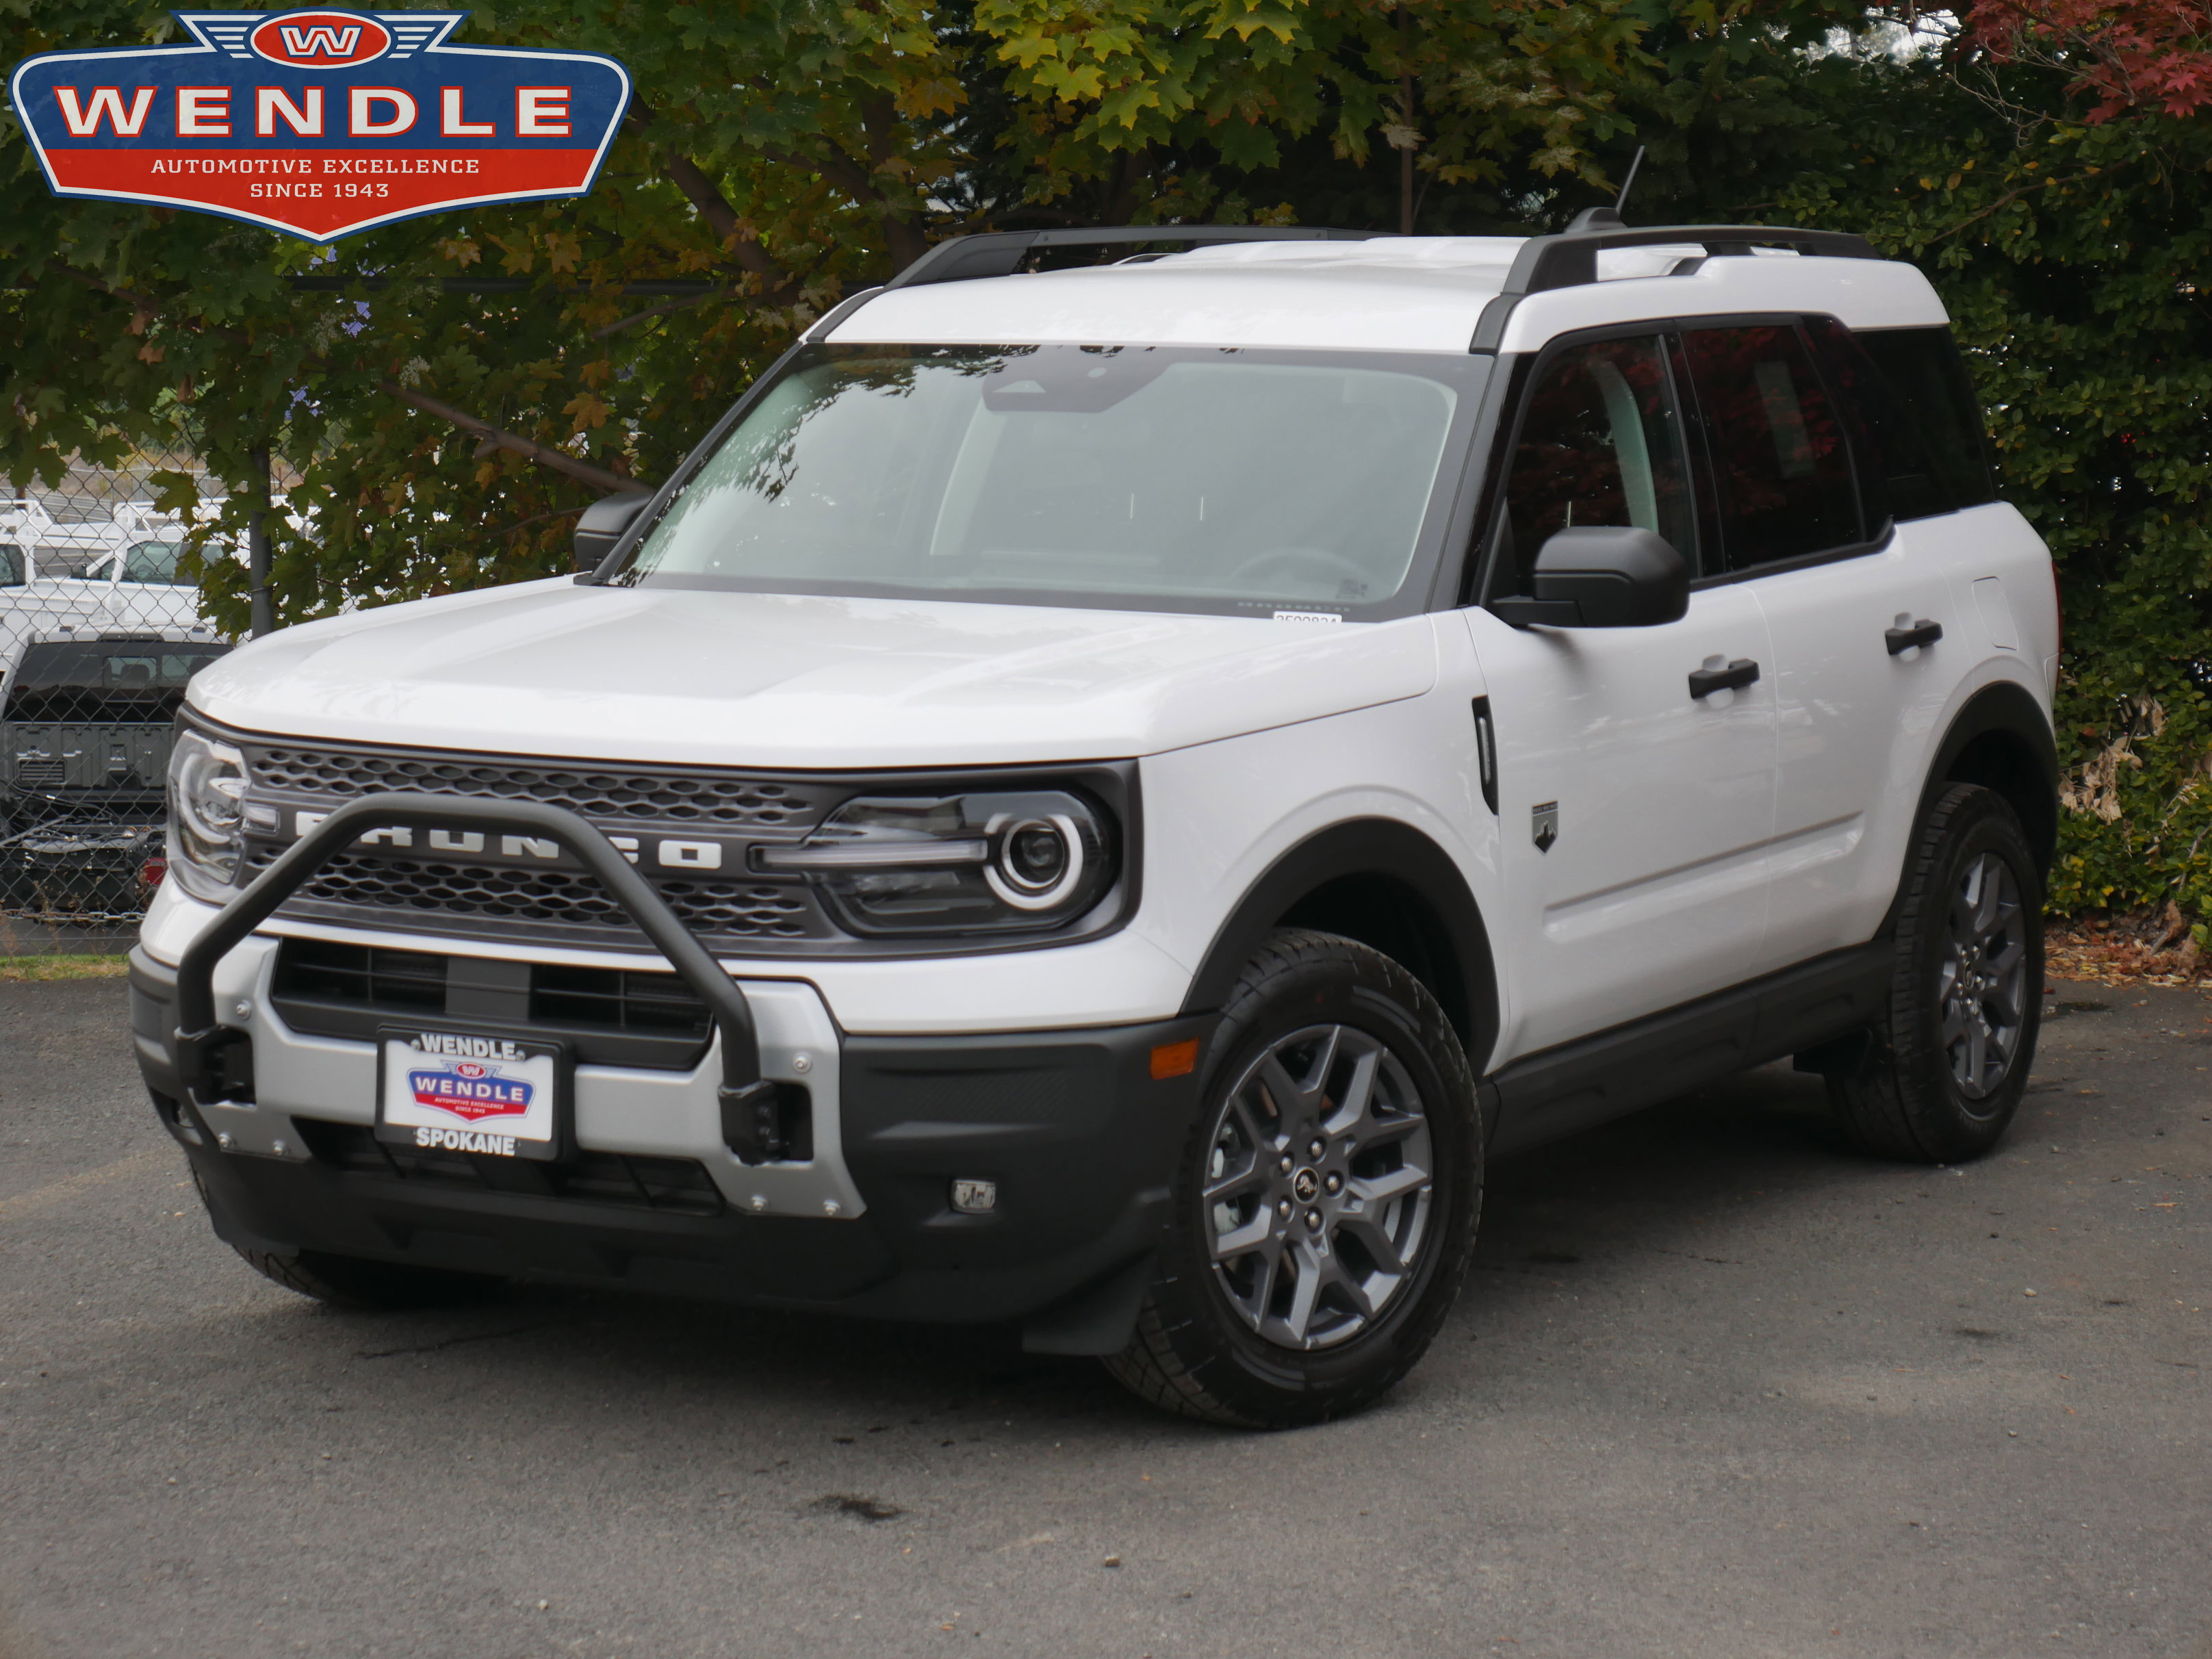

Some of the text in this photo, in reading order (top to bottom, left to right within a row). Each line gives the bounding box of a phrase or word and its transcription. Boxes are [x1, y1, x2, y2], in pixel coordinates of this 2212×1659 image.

[420, 1033, 515, 1061] WENDLE
[415, 1077, 524, 1102] WENDLE
[435, 1097, 504, 1110] AUTOMOTIVE EXCELLENCE
[416, 1127, 515, 1156] SPOKANE
